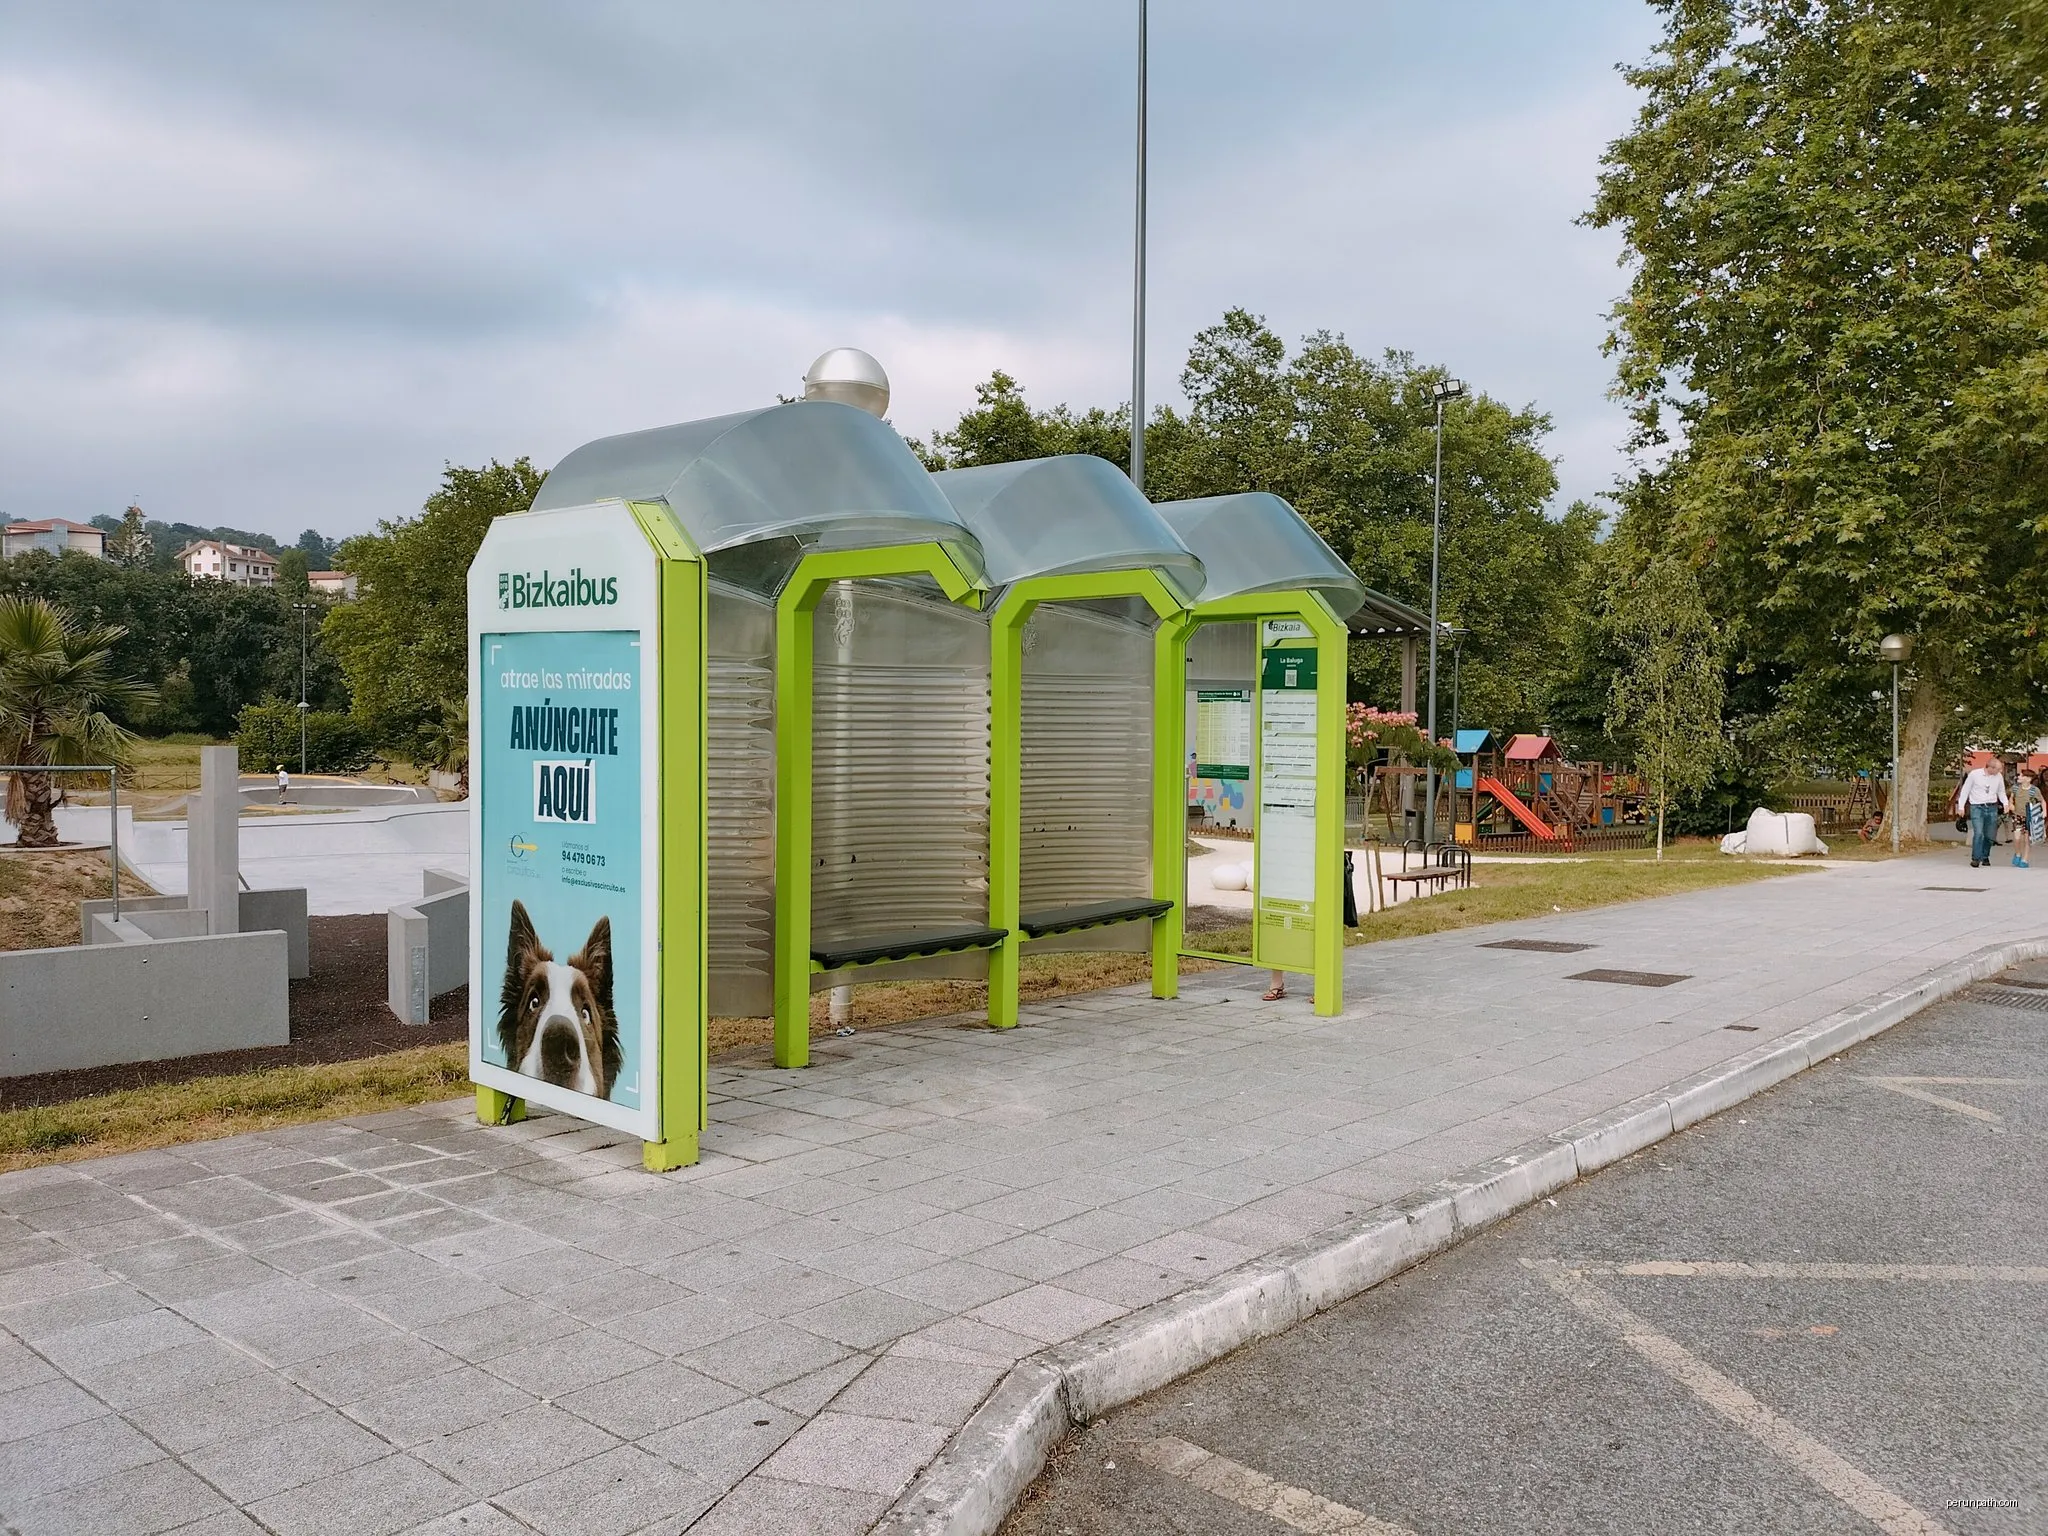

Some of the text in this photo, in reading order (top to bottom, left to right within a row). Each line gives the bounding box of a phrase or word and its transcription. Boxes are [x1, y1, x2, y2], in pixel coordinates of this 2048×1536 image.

[513, 568, 618, 608] Bizkaibus
[500, 667, 632, 690] atrae las miradas
[510, 697, 619, 756] ANÚNCIATE
[537, 757, 593, 822] AQUÍ
[561, 850, 606, 867] 94 479 06 73
